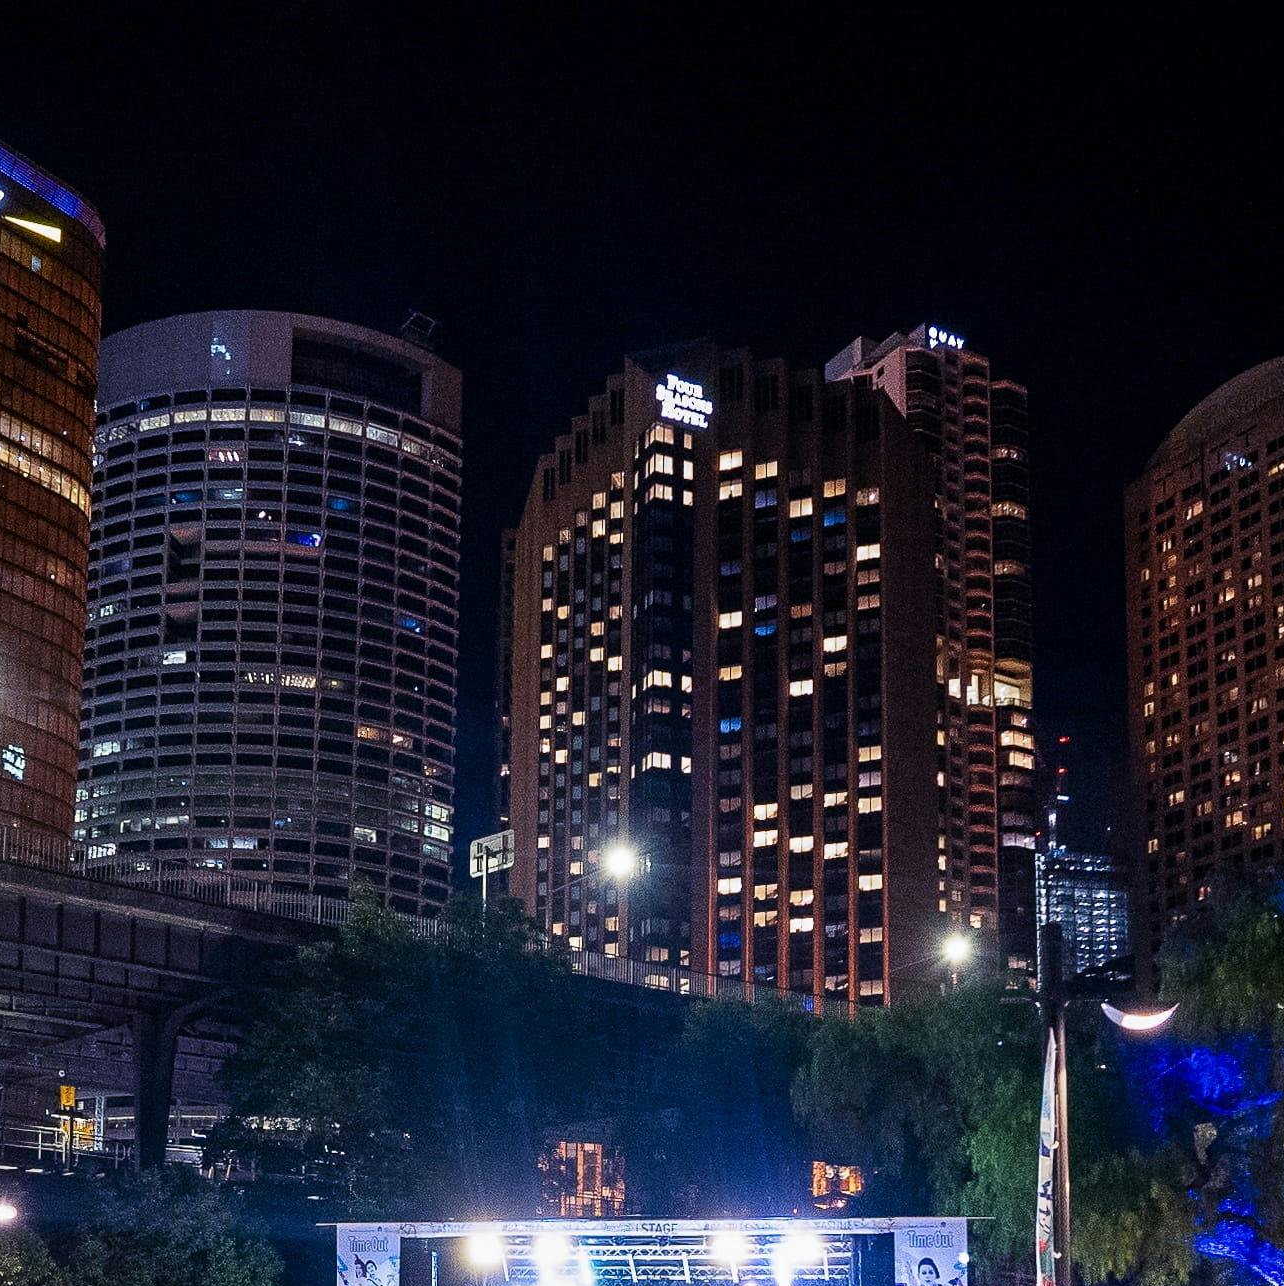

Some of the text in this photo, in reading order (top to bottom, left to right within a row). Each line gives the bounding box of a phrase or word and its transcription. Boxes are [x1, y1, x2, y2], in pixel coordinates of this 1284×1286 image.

[928, 326, 965, 350] QUAY
[666, 373, 704, 399] FOUR
[641, 1222, 679, 1234] STAGE
